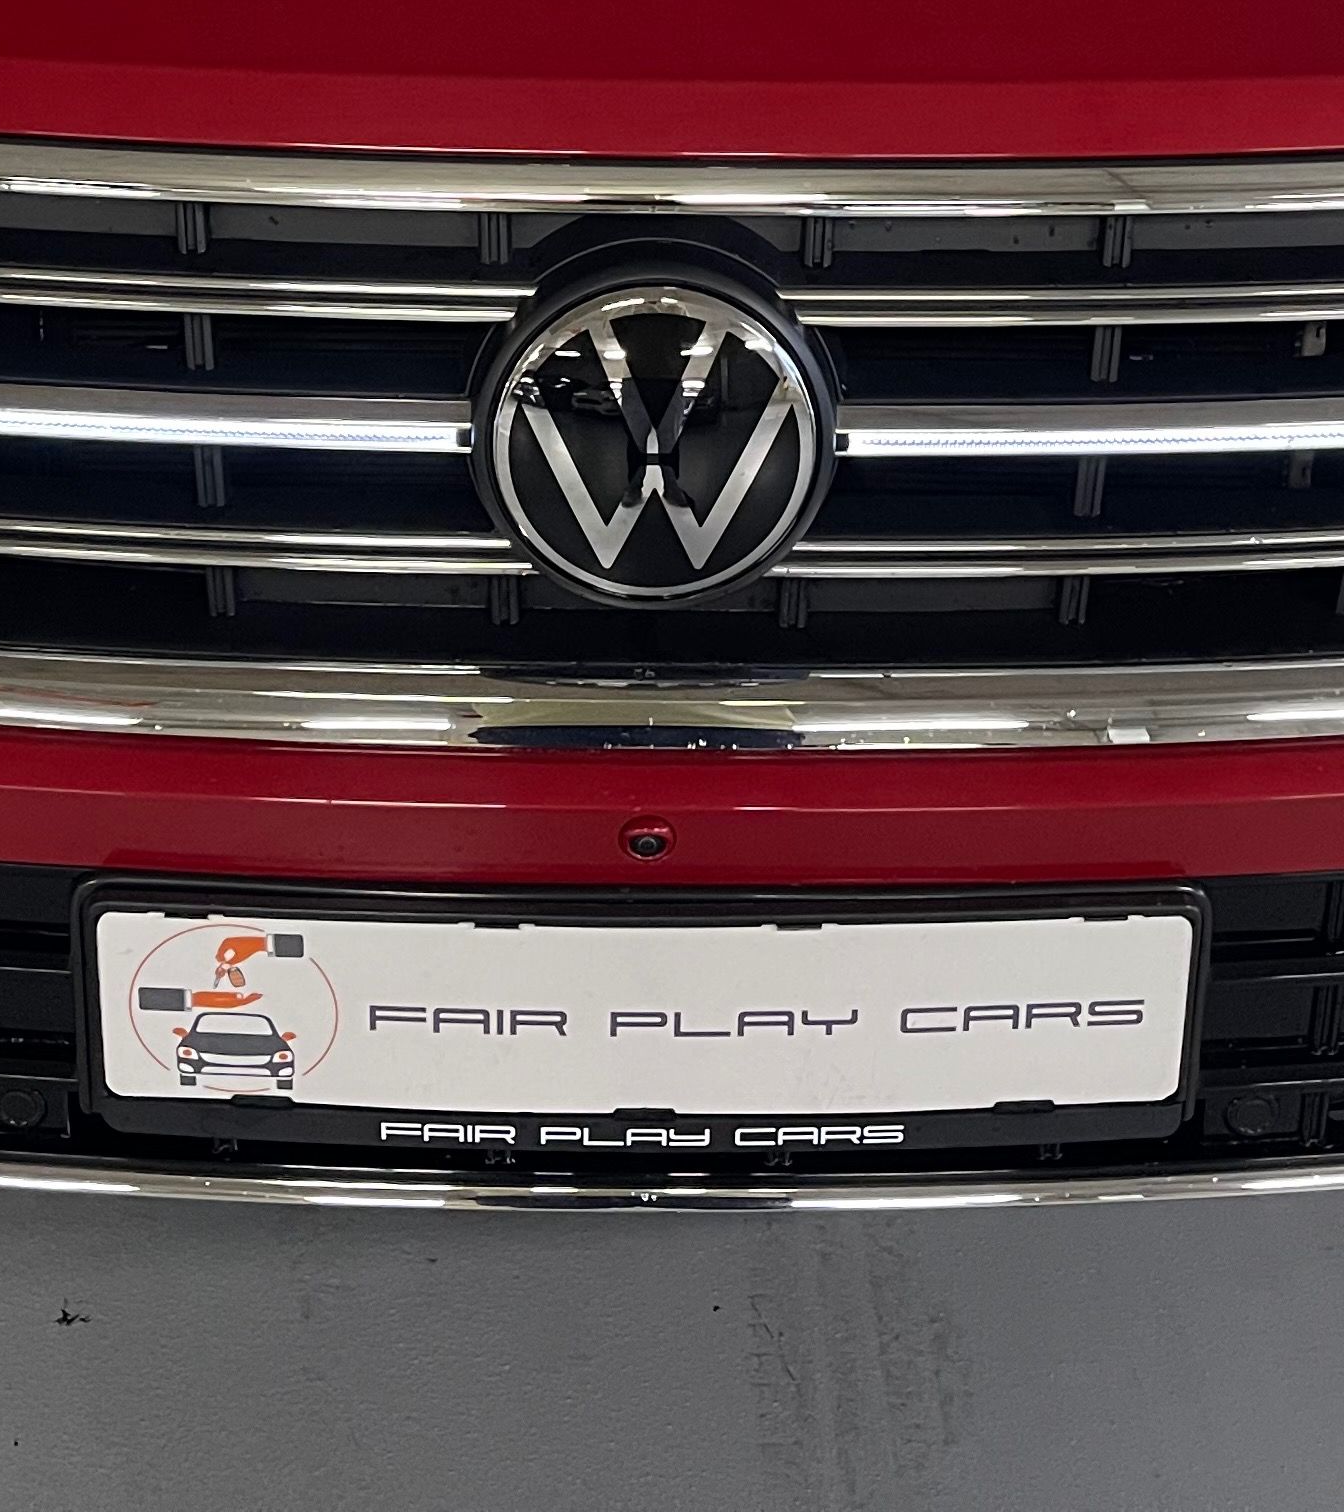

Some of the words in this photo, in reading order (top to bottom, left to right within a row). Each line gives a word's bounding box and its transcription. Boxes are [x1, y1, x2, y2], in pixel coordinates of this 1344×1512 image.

[518, 313, 798, 572] VW
[369, 1005, 568, 1037] FAIR
[610, 1008, 859, 1038] PLAY
[900, 999, 1145, 1034] CARS
[380, 1121, 516, 1145] FAIR
[540, 1126, 711, 1147] PLAY
[734, 1124, 905, 1147] CARS
